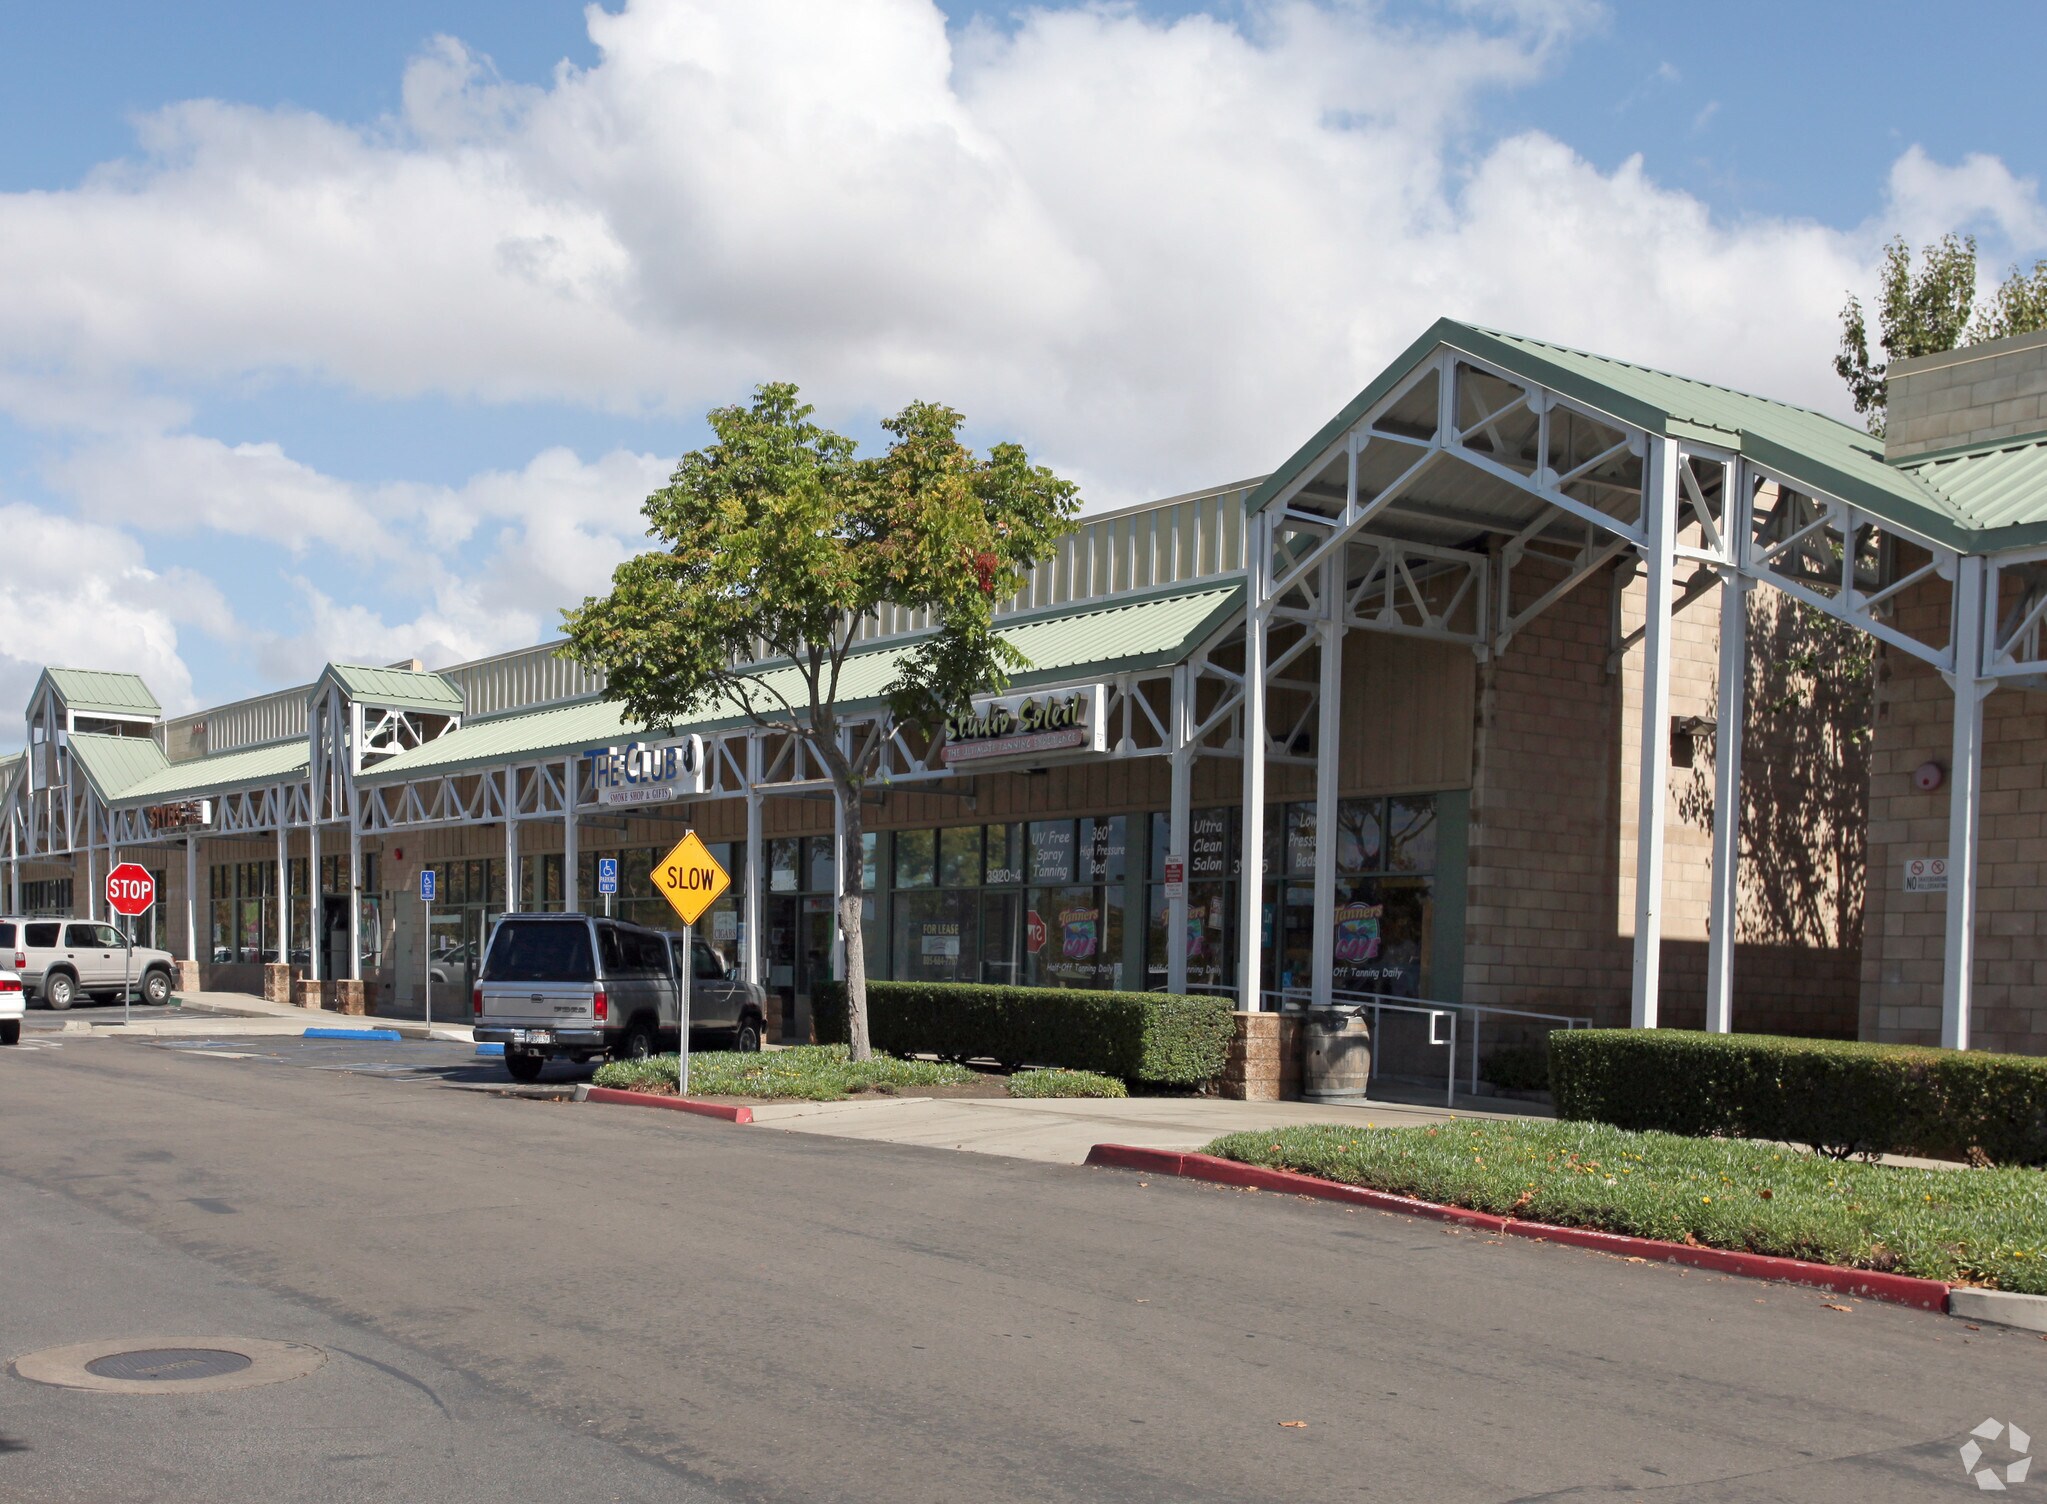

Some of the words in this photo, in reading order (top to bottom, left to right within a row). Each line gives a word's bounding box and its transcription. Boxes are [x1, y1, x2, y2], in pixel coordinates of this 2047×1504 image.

[945, 703, 1011, 740] Studio
[1018, 692, 1081, 731] Soleil
[948, 748, 960, 757] THE
[963, 741, 996, 755] ULTIMATE
[999, 738, 1030, 751] TANNING
[1033, 733, 1076, 746] EXPERIENCE
[583, 747, 620, 789] THE
[625, 741, 678, 784] CLUB
[610, 792, 628, 802] SMOKE
[630, 791, 645, 801] SHOP
[652, 788, 669, 799] GIFTS
[1193, 820, 1222, 833] Ultra
[1300, 814, 1317, 827] Low
[1032, 832, 1046, 845] UV
[1048, 831, 1070, 844] Free
[1080, 846, 1094, 859] High
[1096, 845, 1125, 856] Pressure
[1193, 839, 1222, 852] Clean
[1037, 849, 1063, 864] Spray
[1295, 853, 1316, 867] Beds
[1090, 860, 1107, 874] Bed
[1192, 857, 1222, 871] Salon
[667, 866, 715, 891] SLOW
[987, 869, 1022, 883] 3920-4
[1033, 864, 1068, 880] Tanning
[110, 878, 152, 900] STOP
[602, 883, 614, 891] ONLY
[1906, 876, 1917, 890] NO
[1059, 909, 1099, 927] Tanners
[1334, 904, 1384, 925] Tanners
[714, 929, 736, 939] CIGARS
[923, 923, 937, 935] FOR
[938, 923, 959, 935] LEASE
[1063, 937, 1097, 956] COVE
[1335, 937, 1381, 959] COVE
[1047, 962, 1072, 972] Half-Off
[1075, 963, 1097, 974] Tanning
[1098, 964, 1113, 974] Daily
[1351, 967, 1380, 980] Tanning
[1382, 967, 1404, 980] Daily
